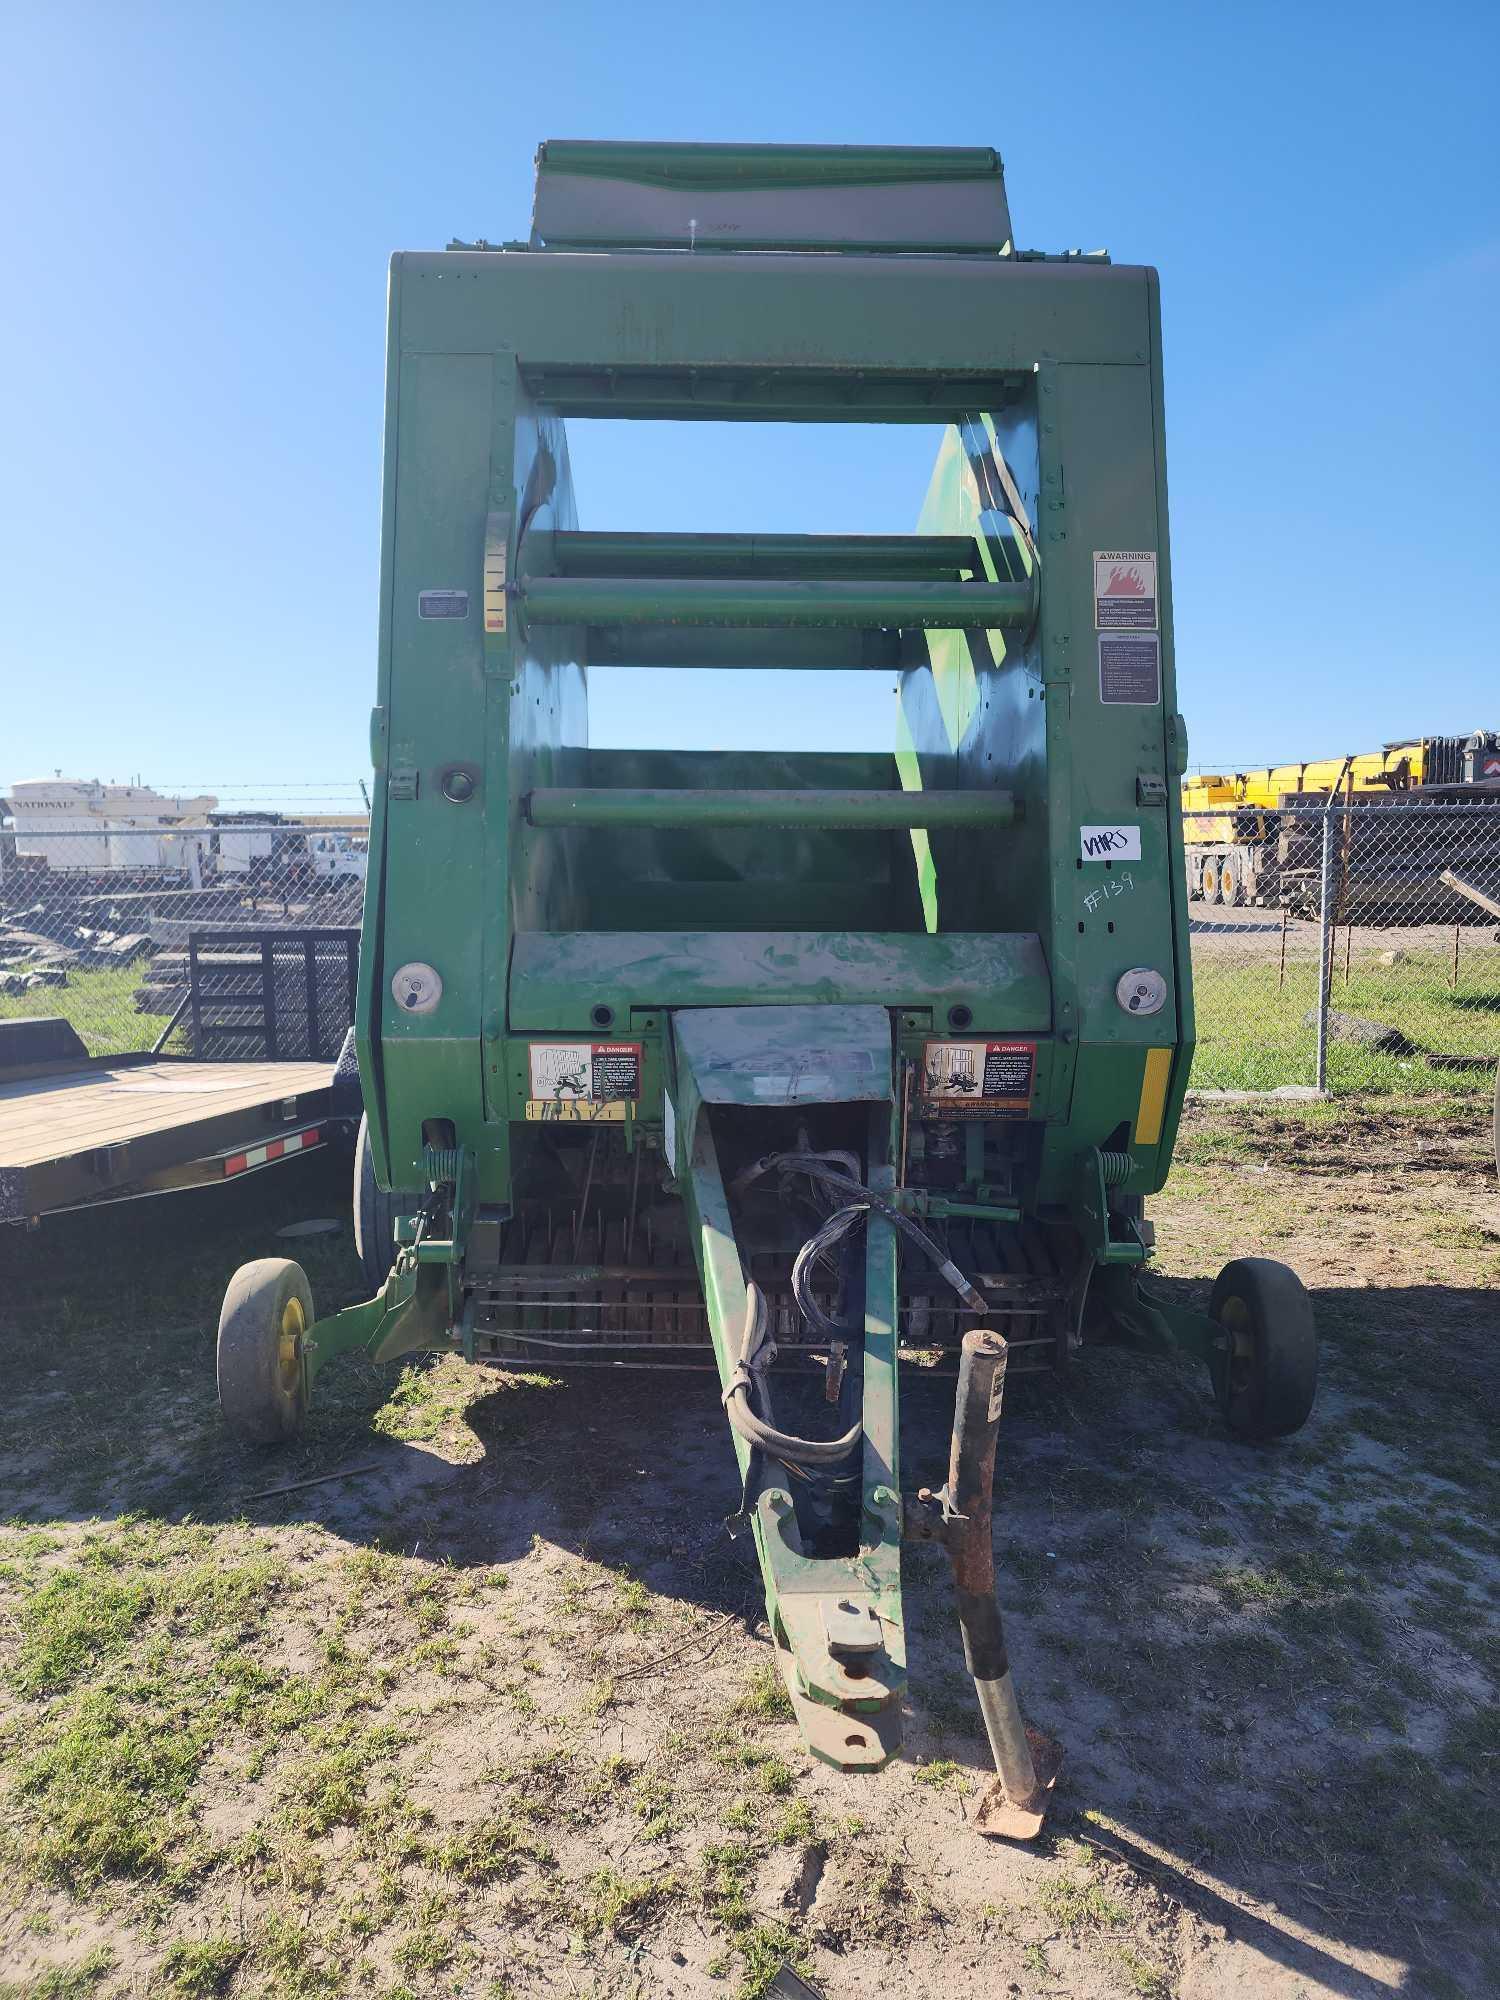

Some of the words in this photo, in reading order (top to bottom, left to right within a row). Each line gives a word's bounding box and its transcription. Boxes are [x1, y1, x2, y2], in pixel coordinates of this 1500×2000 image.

[1107, 552, 1151, 560] WARNING
[14, 800, 70, 809] NATIONAL
[1083, 871, 1135, 913] #139
